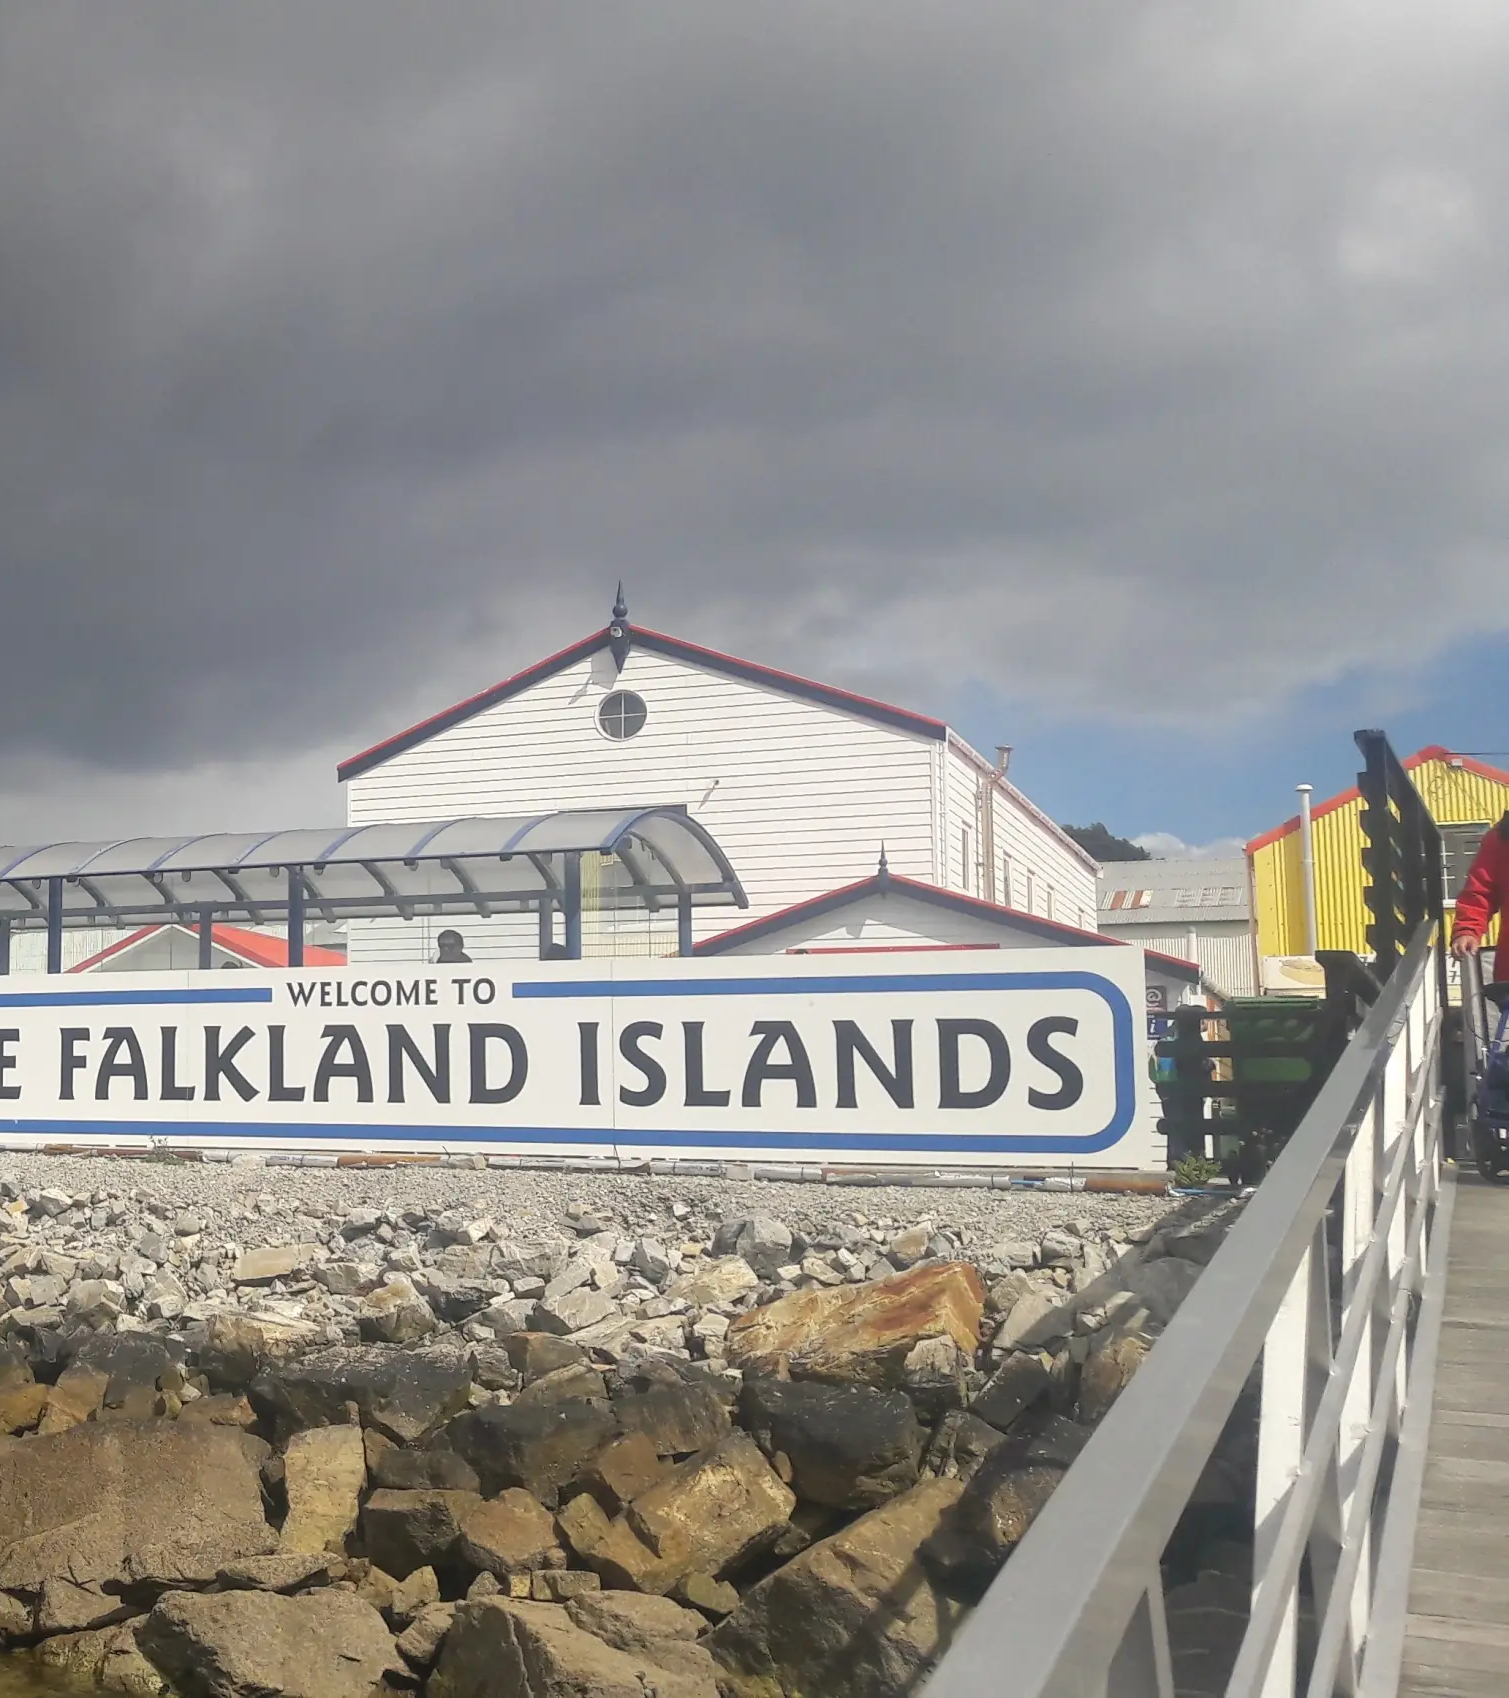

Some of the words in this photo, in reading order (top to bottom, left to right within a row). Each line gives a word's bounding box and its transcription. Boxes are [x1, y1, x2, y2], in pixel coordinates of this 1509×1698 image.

[287, 980, 438, 1006] WELCOME
[452, 979, 495, 1004] TO
[59, 1023, 528, 1104] FALKLAND
[578, 1016, 1083, 1110] ISLANDS
